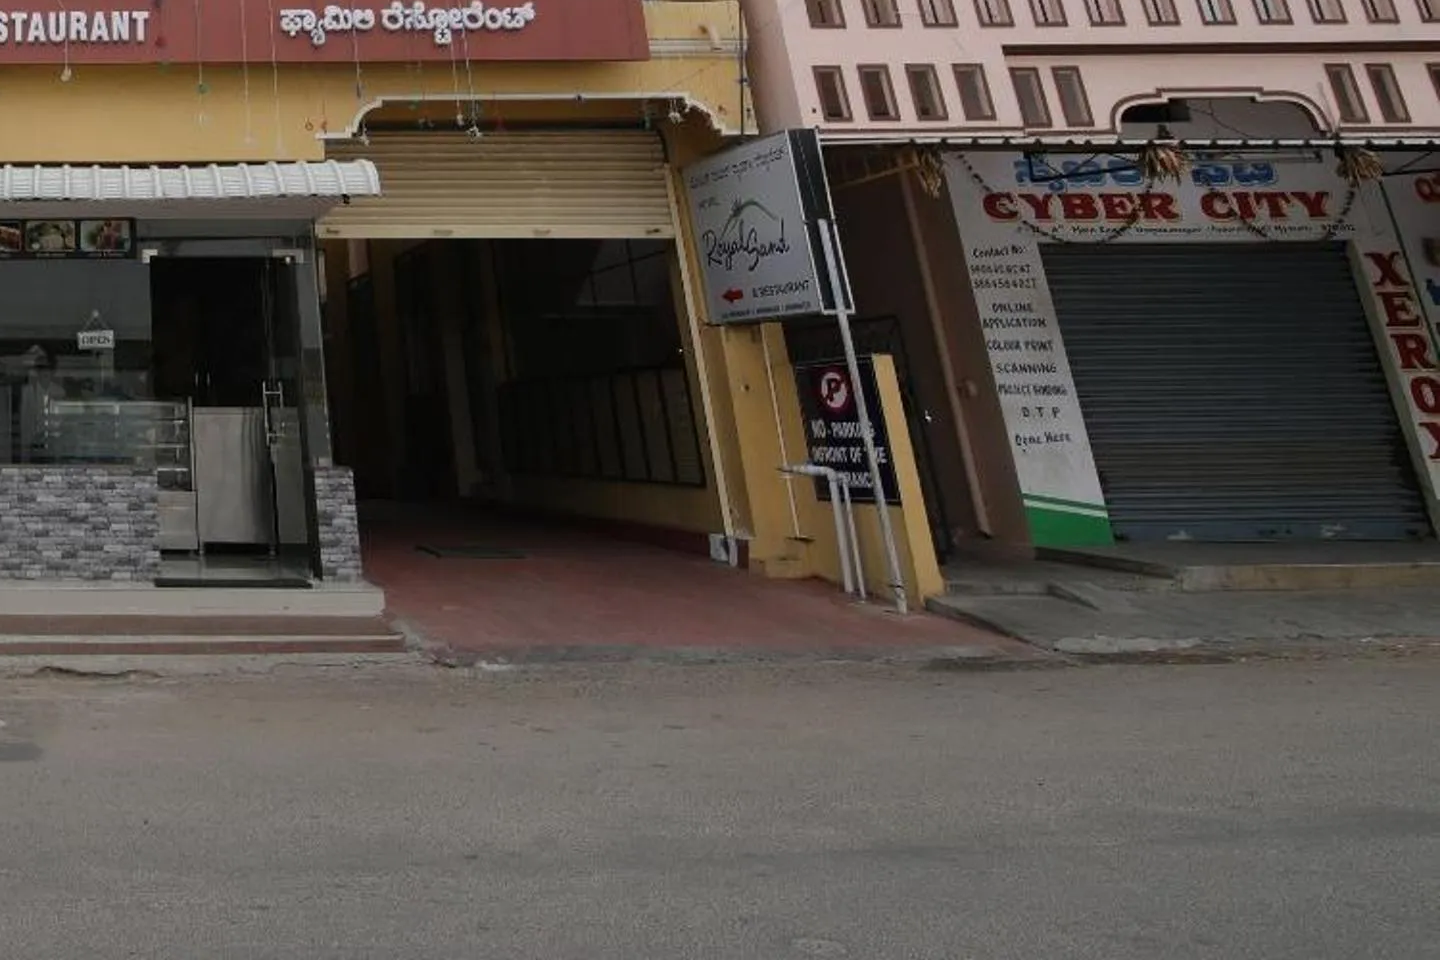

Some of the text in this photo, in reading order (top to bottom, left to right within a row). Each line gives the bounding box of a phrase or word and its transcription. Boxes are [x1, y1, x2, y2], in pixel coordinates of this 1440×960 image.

[982, 191, 1330, 224] CYBER CITY
[996, 362, 1057, 374] SCANNING
